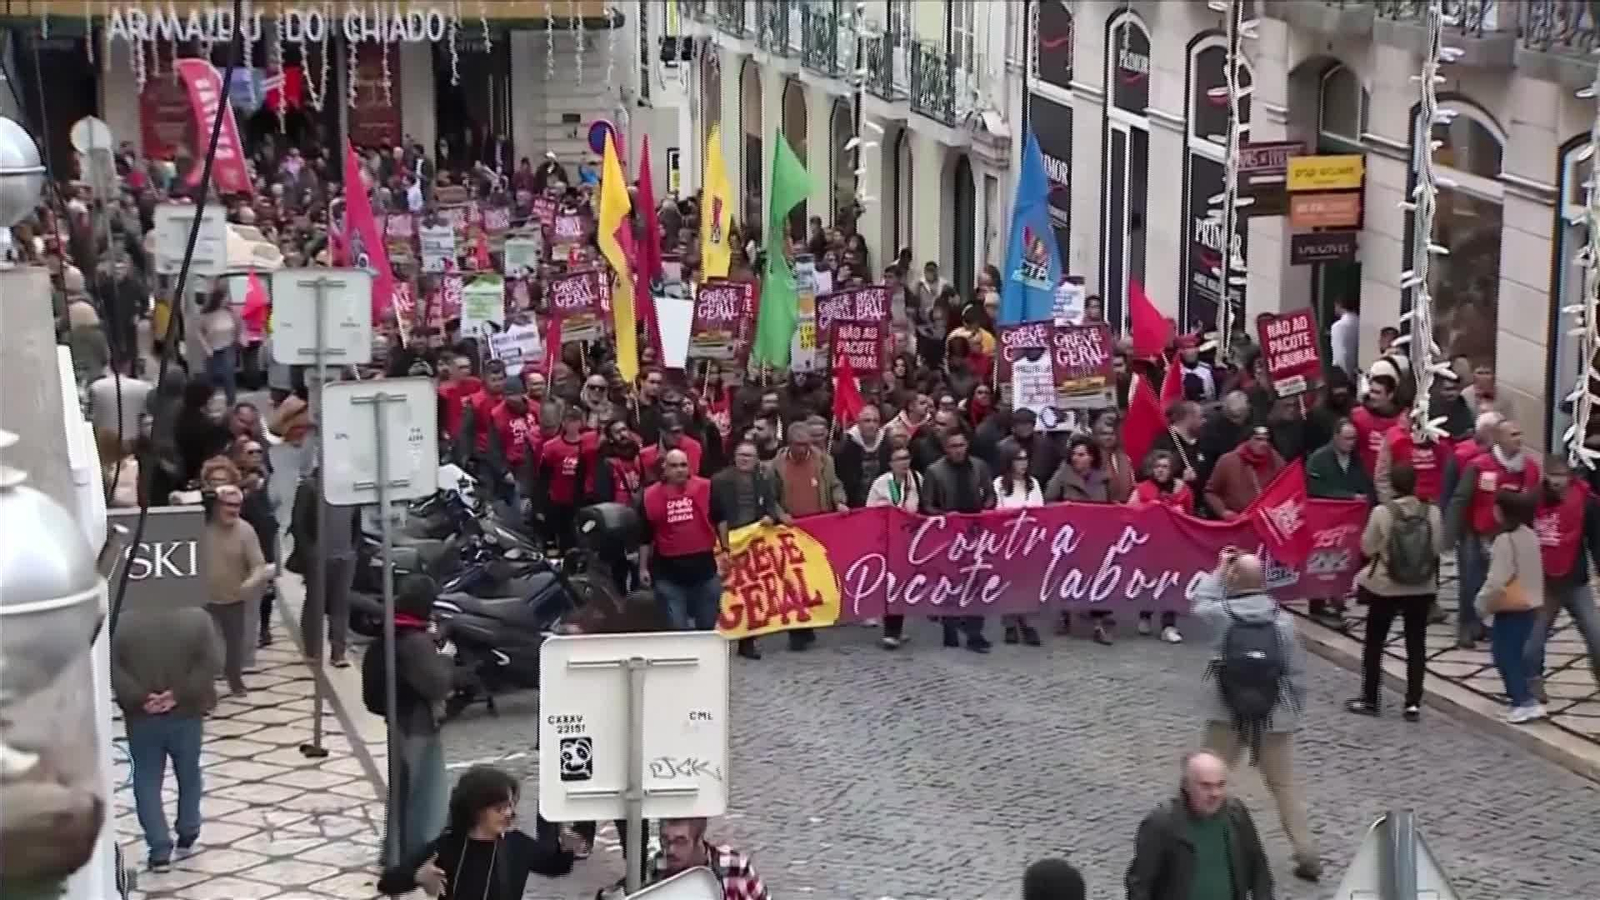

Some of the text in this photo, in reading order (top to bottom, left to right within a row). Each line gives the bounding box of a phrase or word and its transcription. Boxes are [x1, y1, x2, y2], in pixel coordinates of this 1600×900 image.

[285, 10, 326, 41] DO
[343, 10, 444, 42] CHIADO
[1195, 216, 1242, 262] PRIMR
[1001, 323, 1048, 345] GREVE
[1293, 315, 1308, 332] AO
[1053, 327, 1102, 348] GREVE
[1268, 331, 1311, 354] PACOTE
[1056, 342, 1109, 367] GERAL
[1267, 347, 1319, 372] LABORAL
[908, 510, 1150, 565] Contra o
[109, 541, 198, 580] SKI
[727, 533, 807, 587] REVE
[1040, 544, 1264, 602] labora
[688, 711, 713, 721] CML
